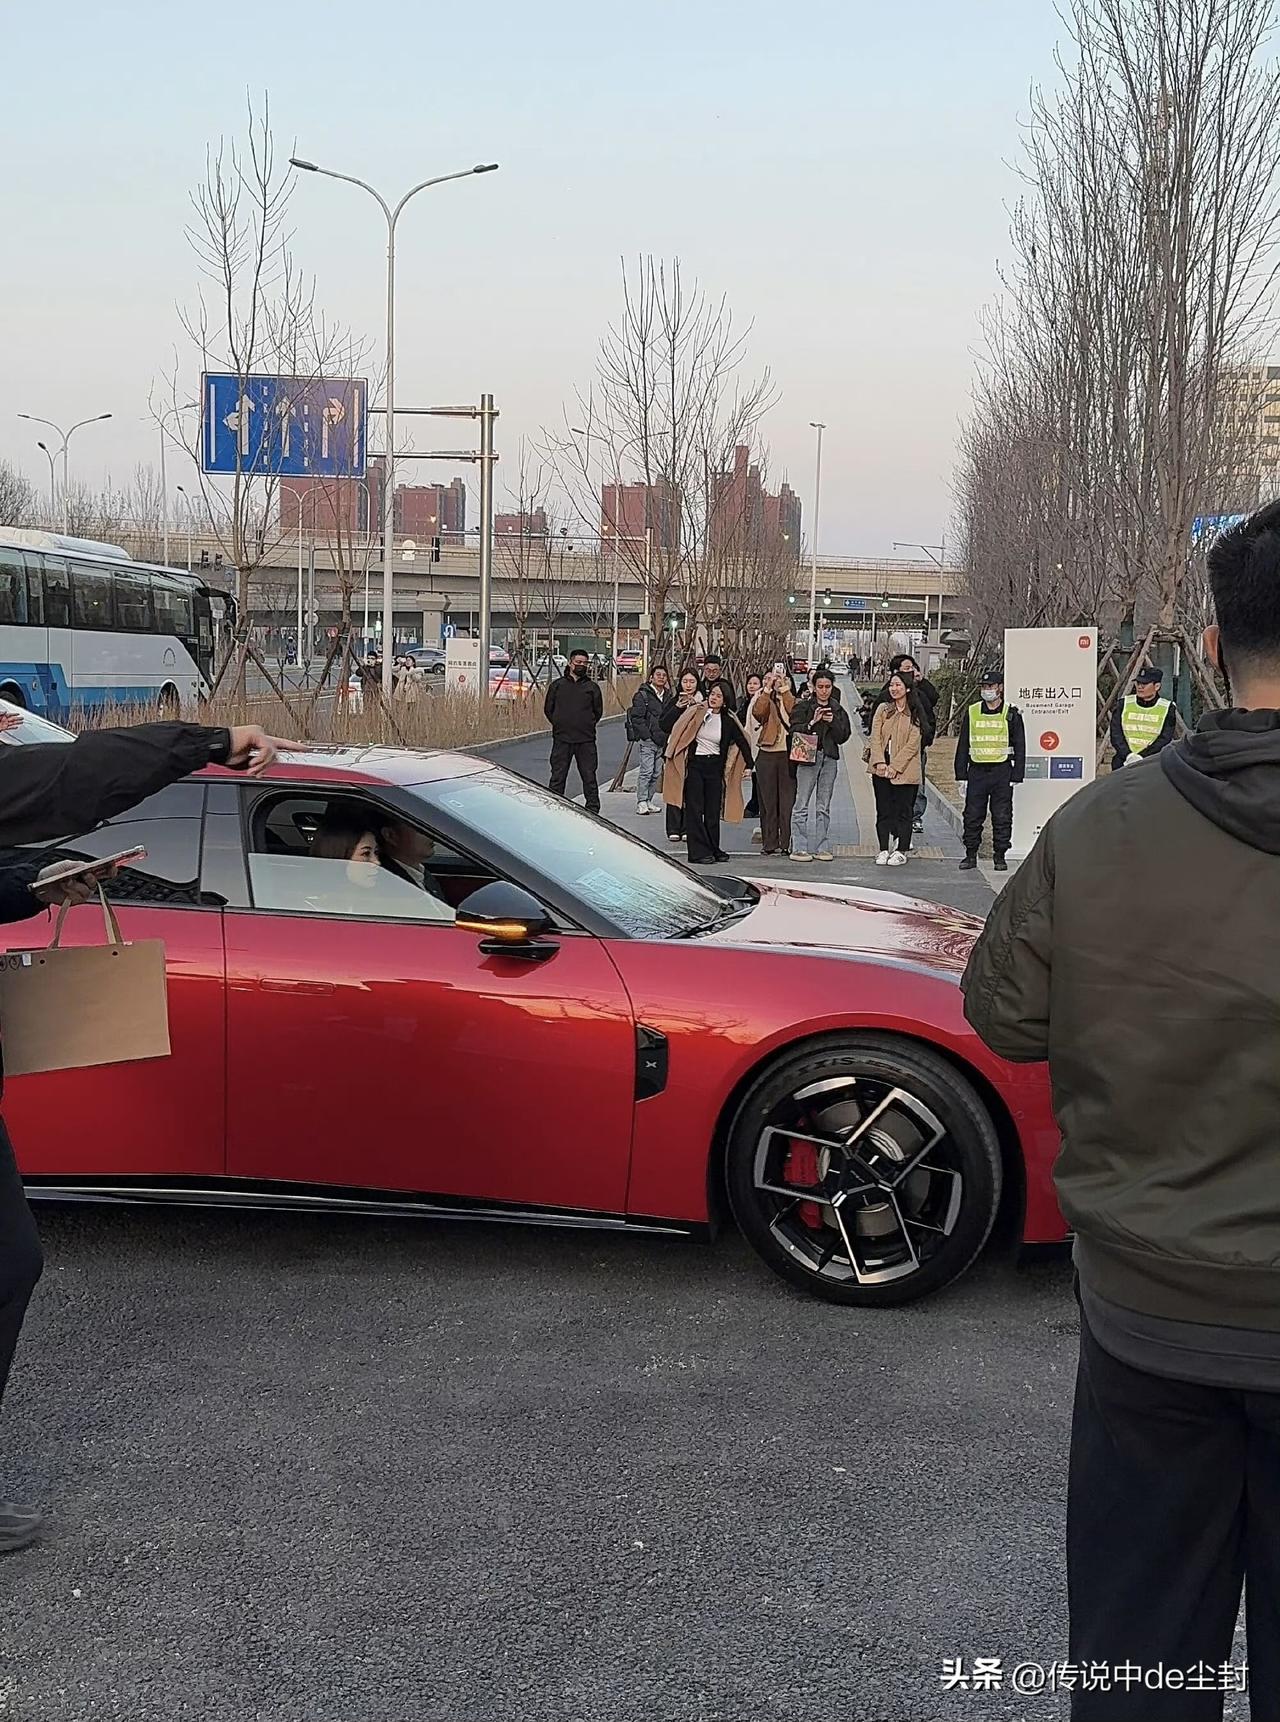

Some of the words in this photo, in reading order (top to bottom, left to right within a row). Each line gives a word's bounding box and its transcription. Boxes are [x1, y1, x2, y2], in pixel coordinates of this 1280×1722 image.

[1018, 687, 1082, 699] 地库出入口
